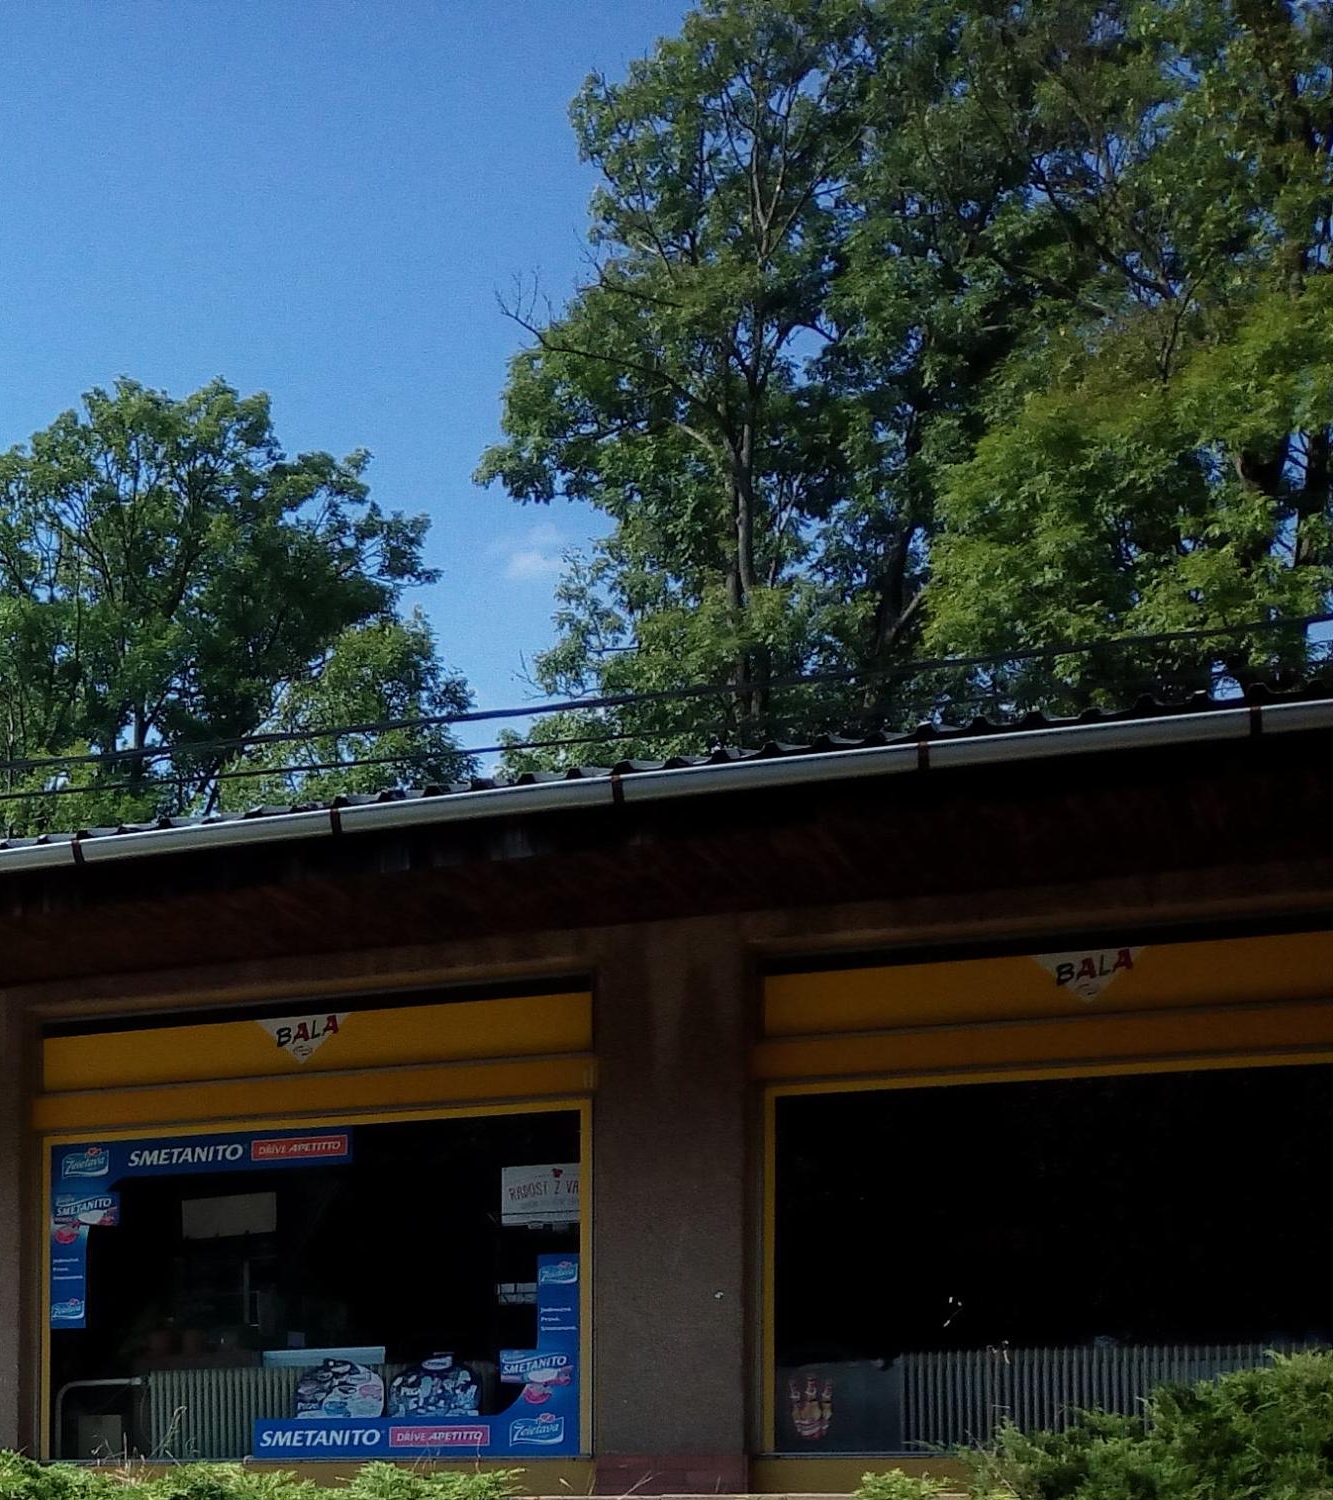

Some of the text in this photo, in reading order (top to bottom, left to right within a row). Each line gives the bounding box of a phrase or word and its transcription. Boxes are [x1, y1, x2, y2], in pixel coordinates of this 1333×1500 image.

[1057, 948, 1134, 986] BALA
[276, 1014, 339, 1048] BALA
[128, 1143, 244, 1167] SMETANITO
[56, 1198, 112, 1216] SMETANITO
[503, 1355, 567, 1374] SMETANITO
[259, 1428, 381, 1447] SMETANITO
[397, 1430, 427, 1442] DŘÍVE
